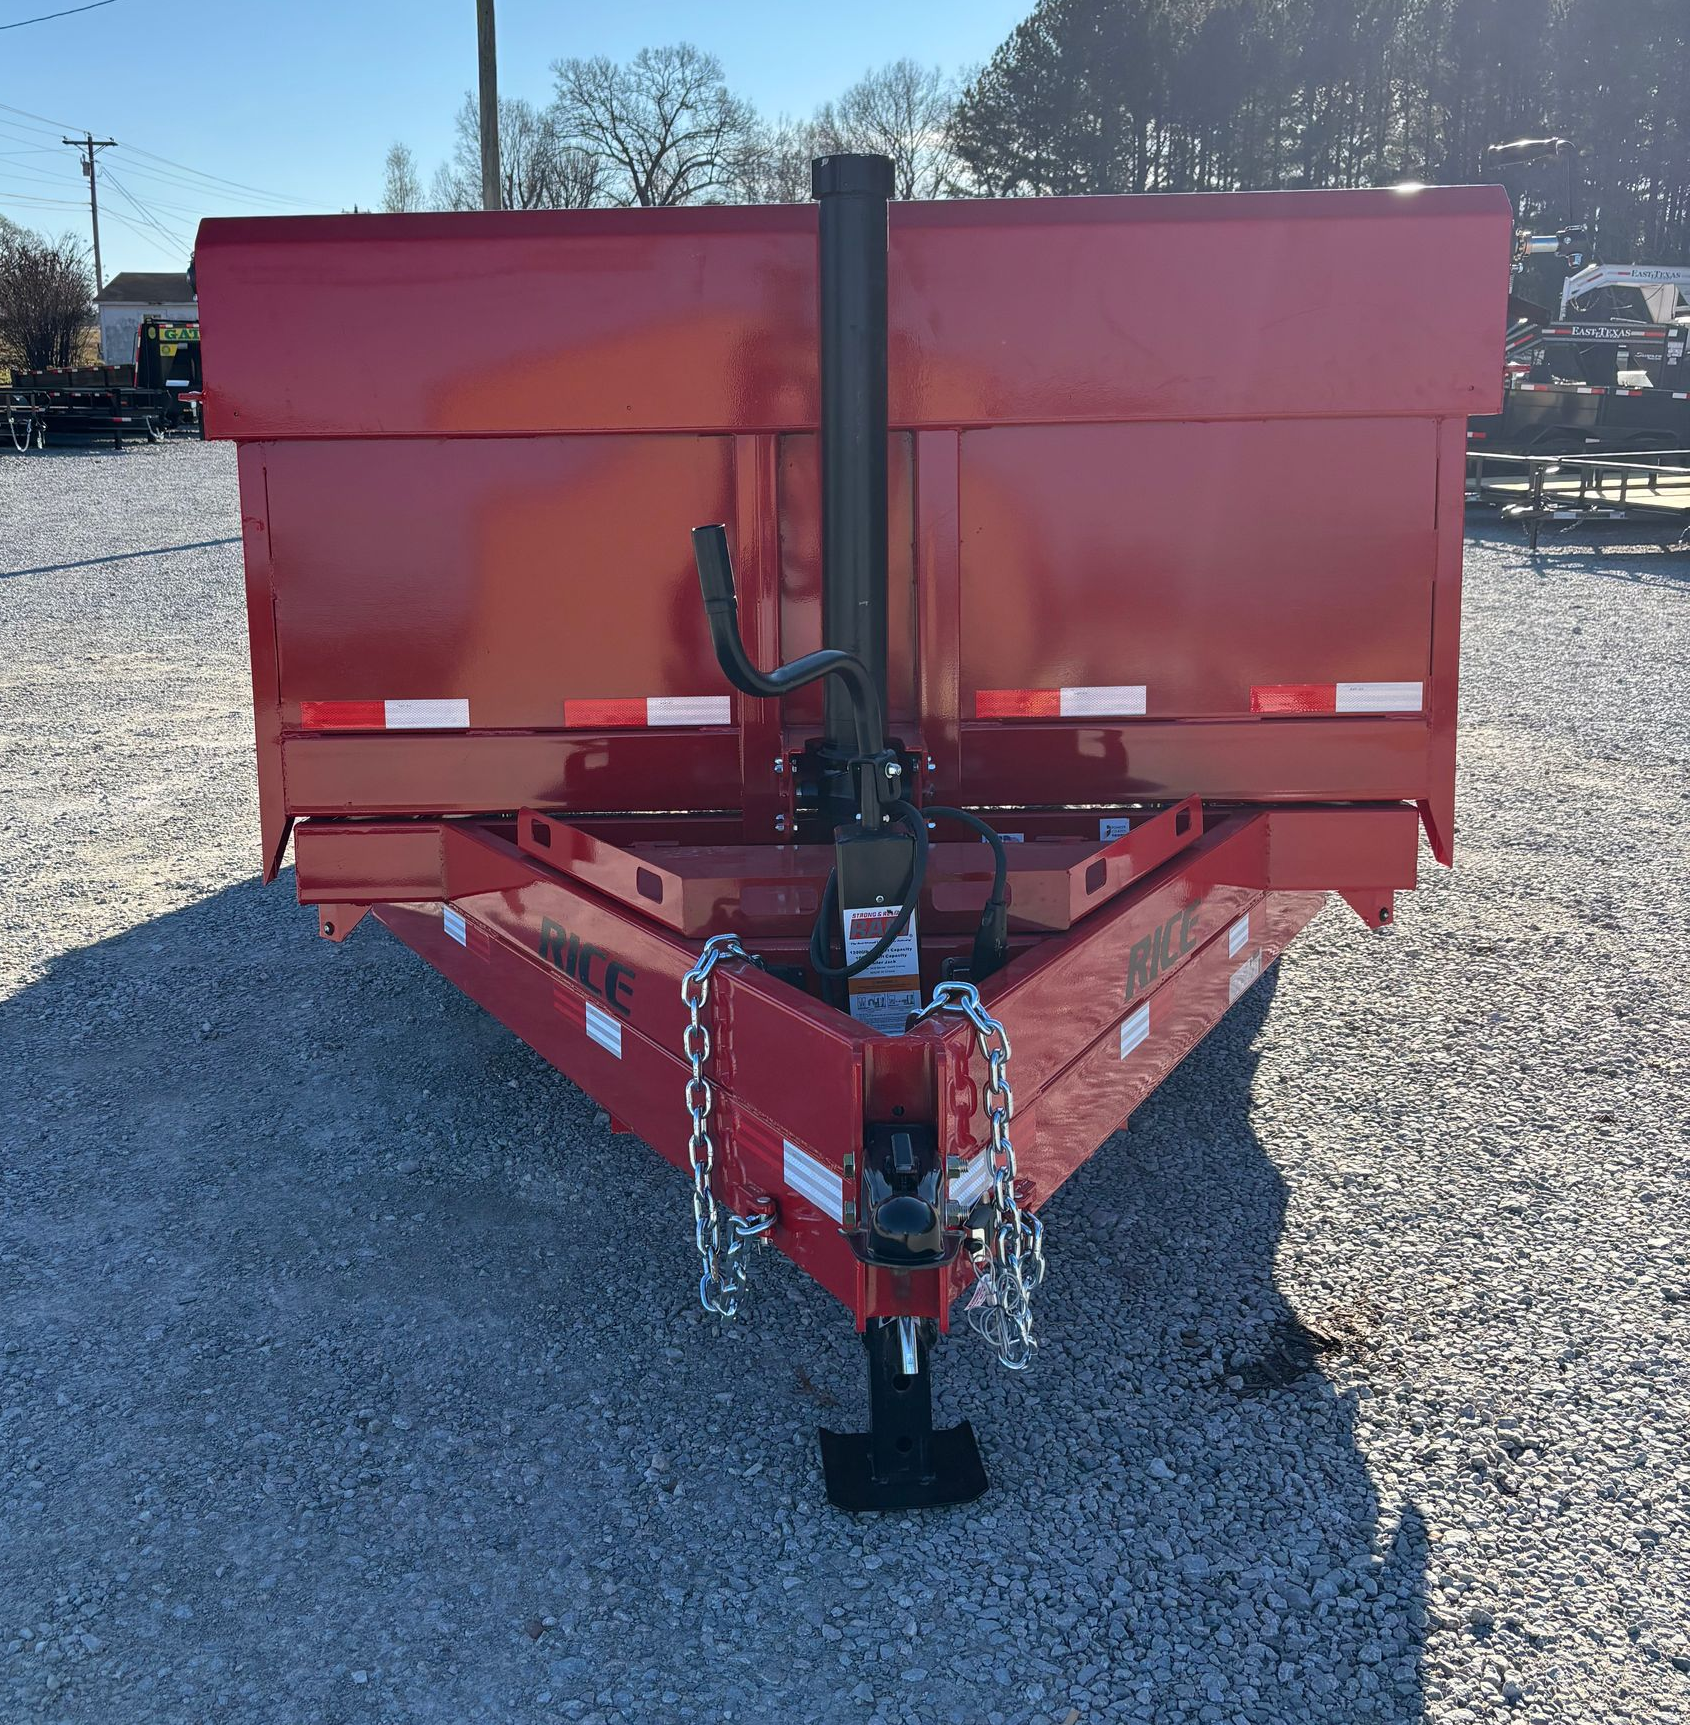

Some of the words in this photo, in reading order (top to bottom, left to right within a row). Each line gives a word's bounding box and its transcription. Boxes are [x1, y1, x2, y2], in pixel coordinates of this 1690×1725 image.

[1571, 326, 1597, 336] EAST
[1598, 326, 1632, 338] TEXAS
[538, 915, 636, 1017] RICE
[1125, 897, 1202, 1002] RICE
